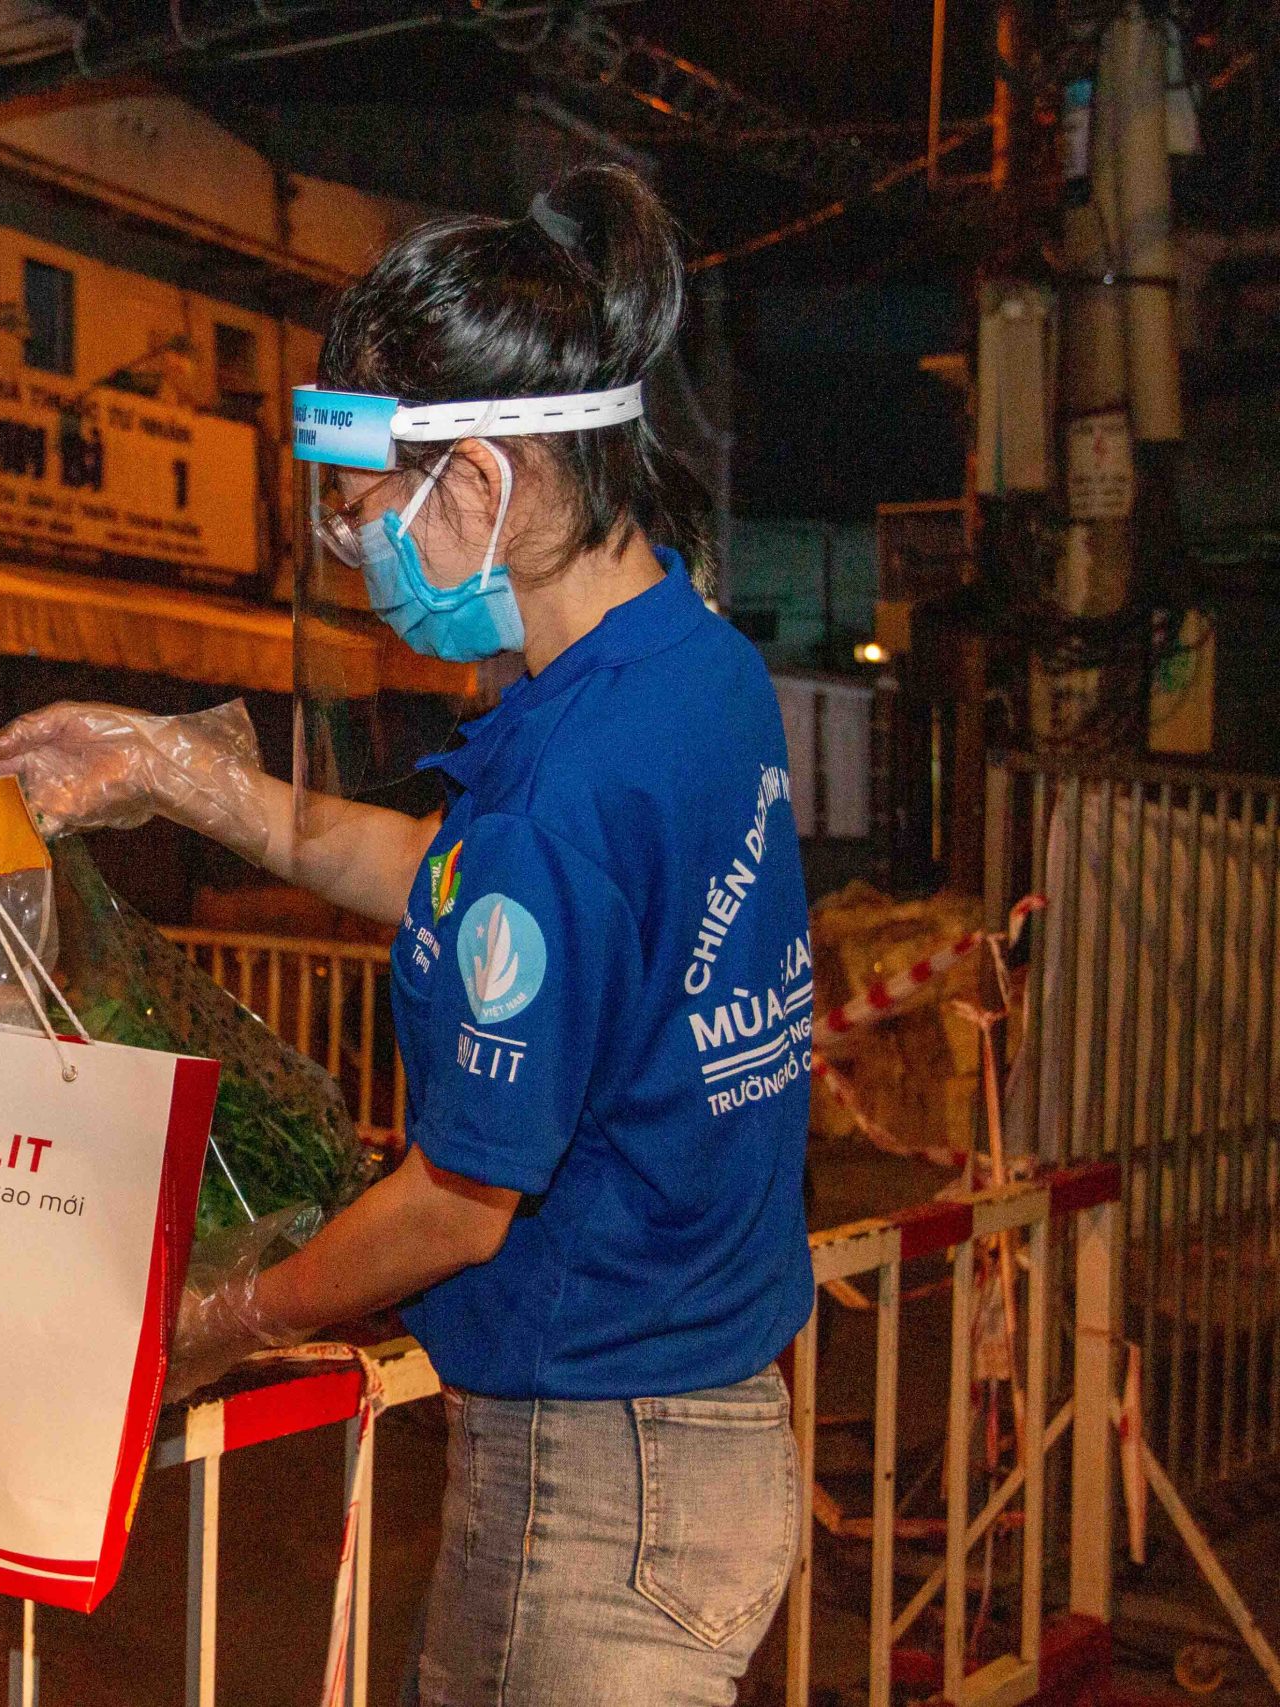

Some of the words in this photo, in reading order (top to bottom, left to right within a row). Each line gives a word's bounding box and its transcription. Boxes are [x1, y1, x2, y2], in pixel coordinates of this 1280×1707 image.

[313, 408, 329, 425] TIN
[330, 409, 354, 430] HỌC
[683, 858, 757, 995] CHIẾN
[687, 986, 784, 1053] MÙA
[707, 1067, 786, 1117] TRƯỜNG
[39, 1193, 86, 1217] mới
